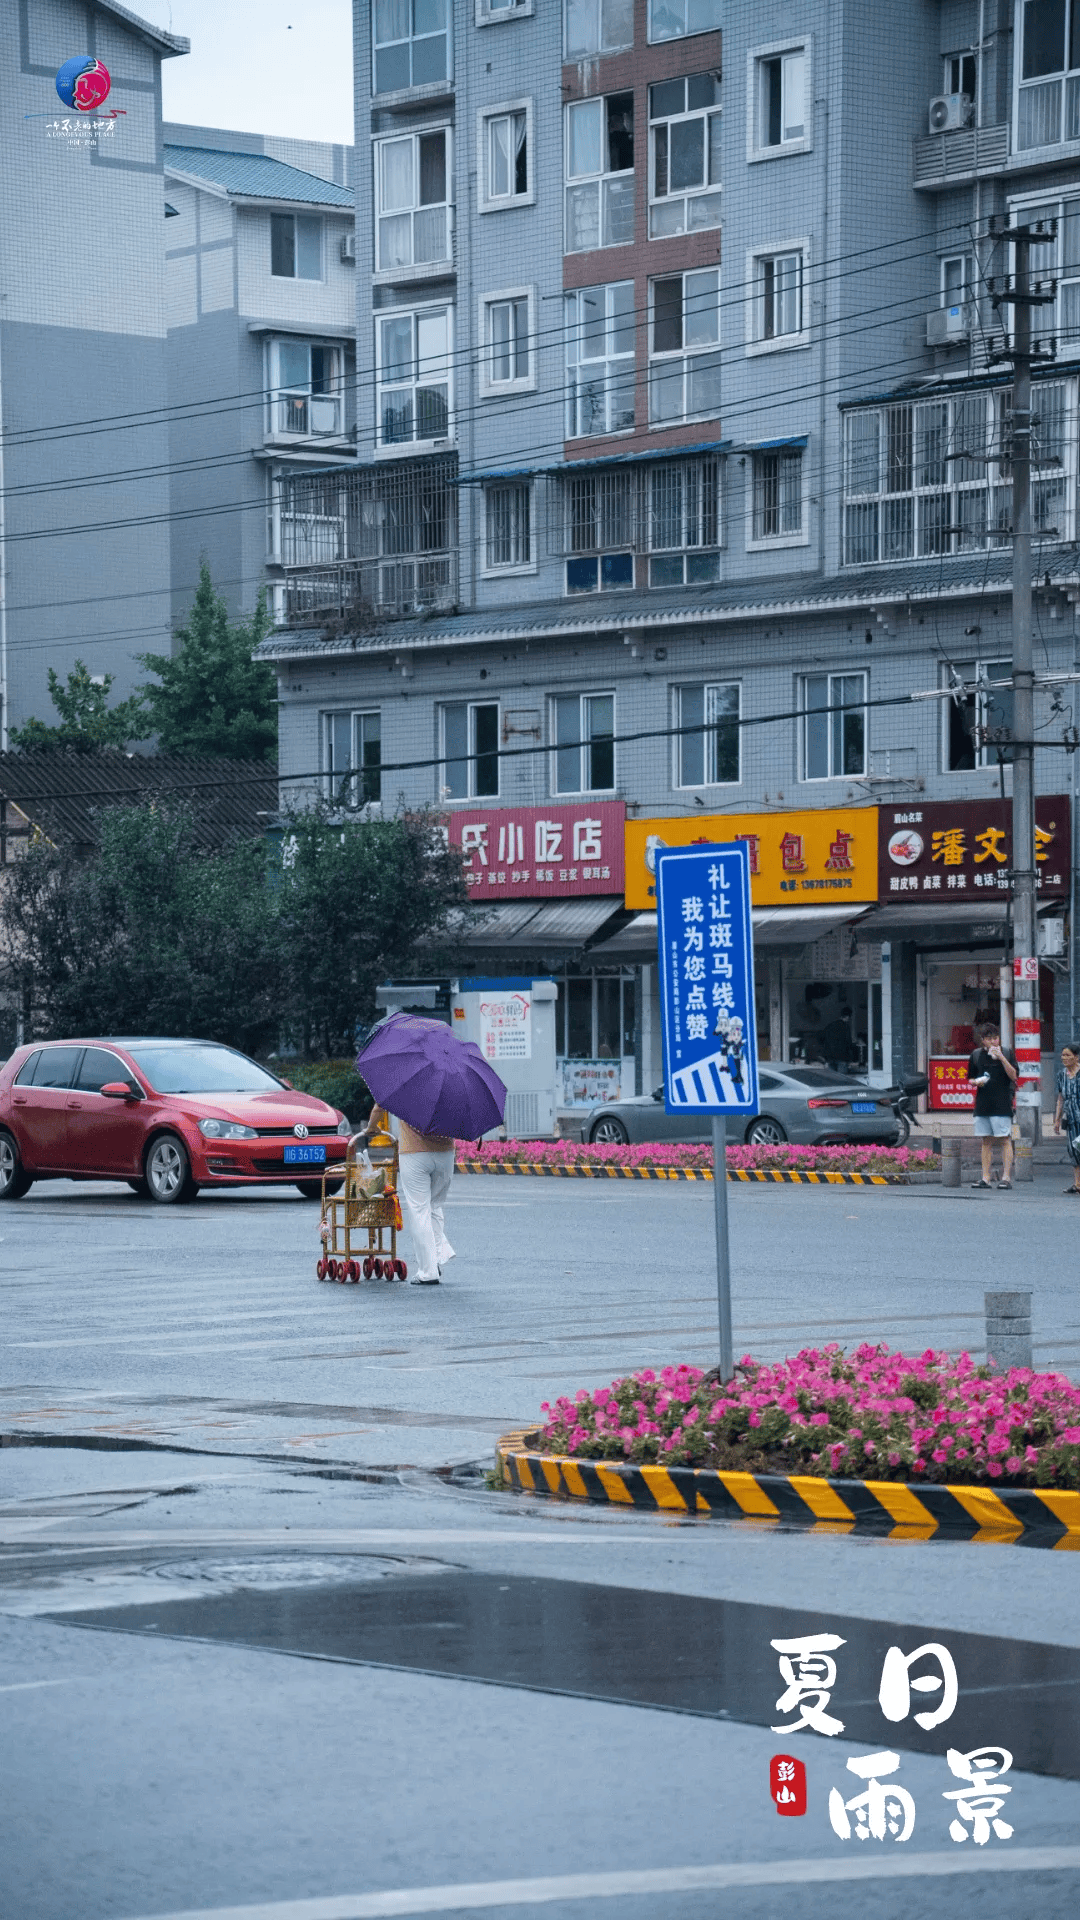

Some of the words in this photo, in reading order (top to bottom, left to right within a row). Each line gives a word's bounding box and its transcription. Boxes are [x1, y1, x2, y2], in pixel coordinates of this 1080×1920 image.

[894, 812, 923, 824] 眉山名菜
[422, 818, 602, 867] 氏小吃店
[511, 870, 530, 883] 抄手
[559, 868, 578, 882] 豆浆
[582, 866, 610, 880] 银耳汤
[890, 877, 918, 891] 甜皮鸭
[923, 875, 942, 890] 卤菜
[947, 874, 967, 889] 拌菜
[1045, 874, 1062, 885] 二店
[708, 864, 736, 1010] 礼让斑马线
[682, 896, 709, 1041] 我为您点赞
